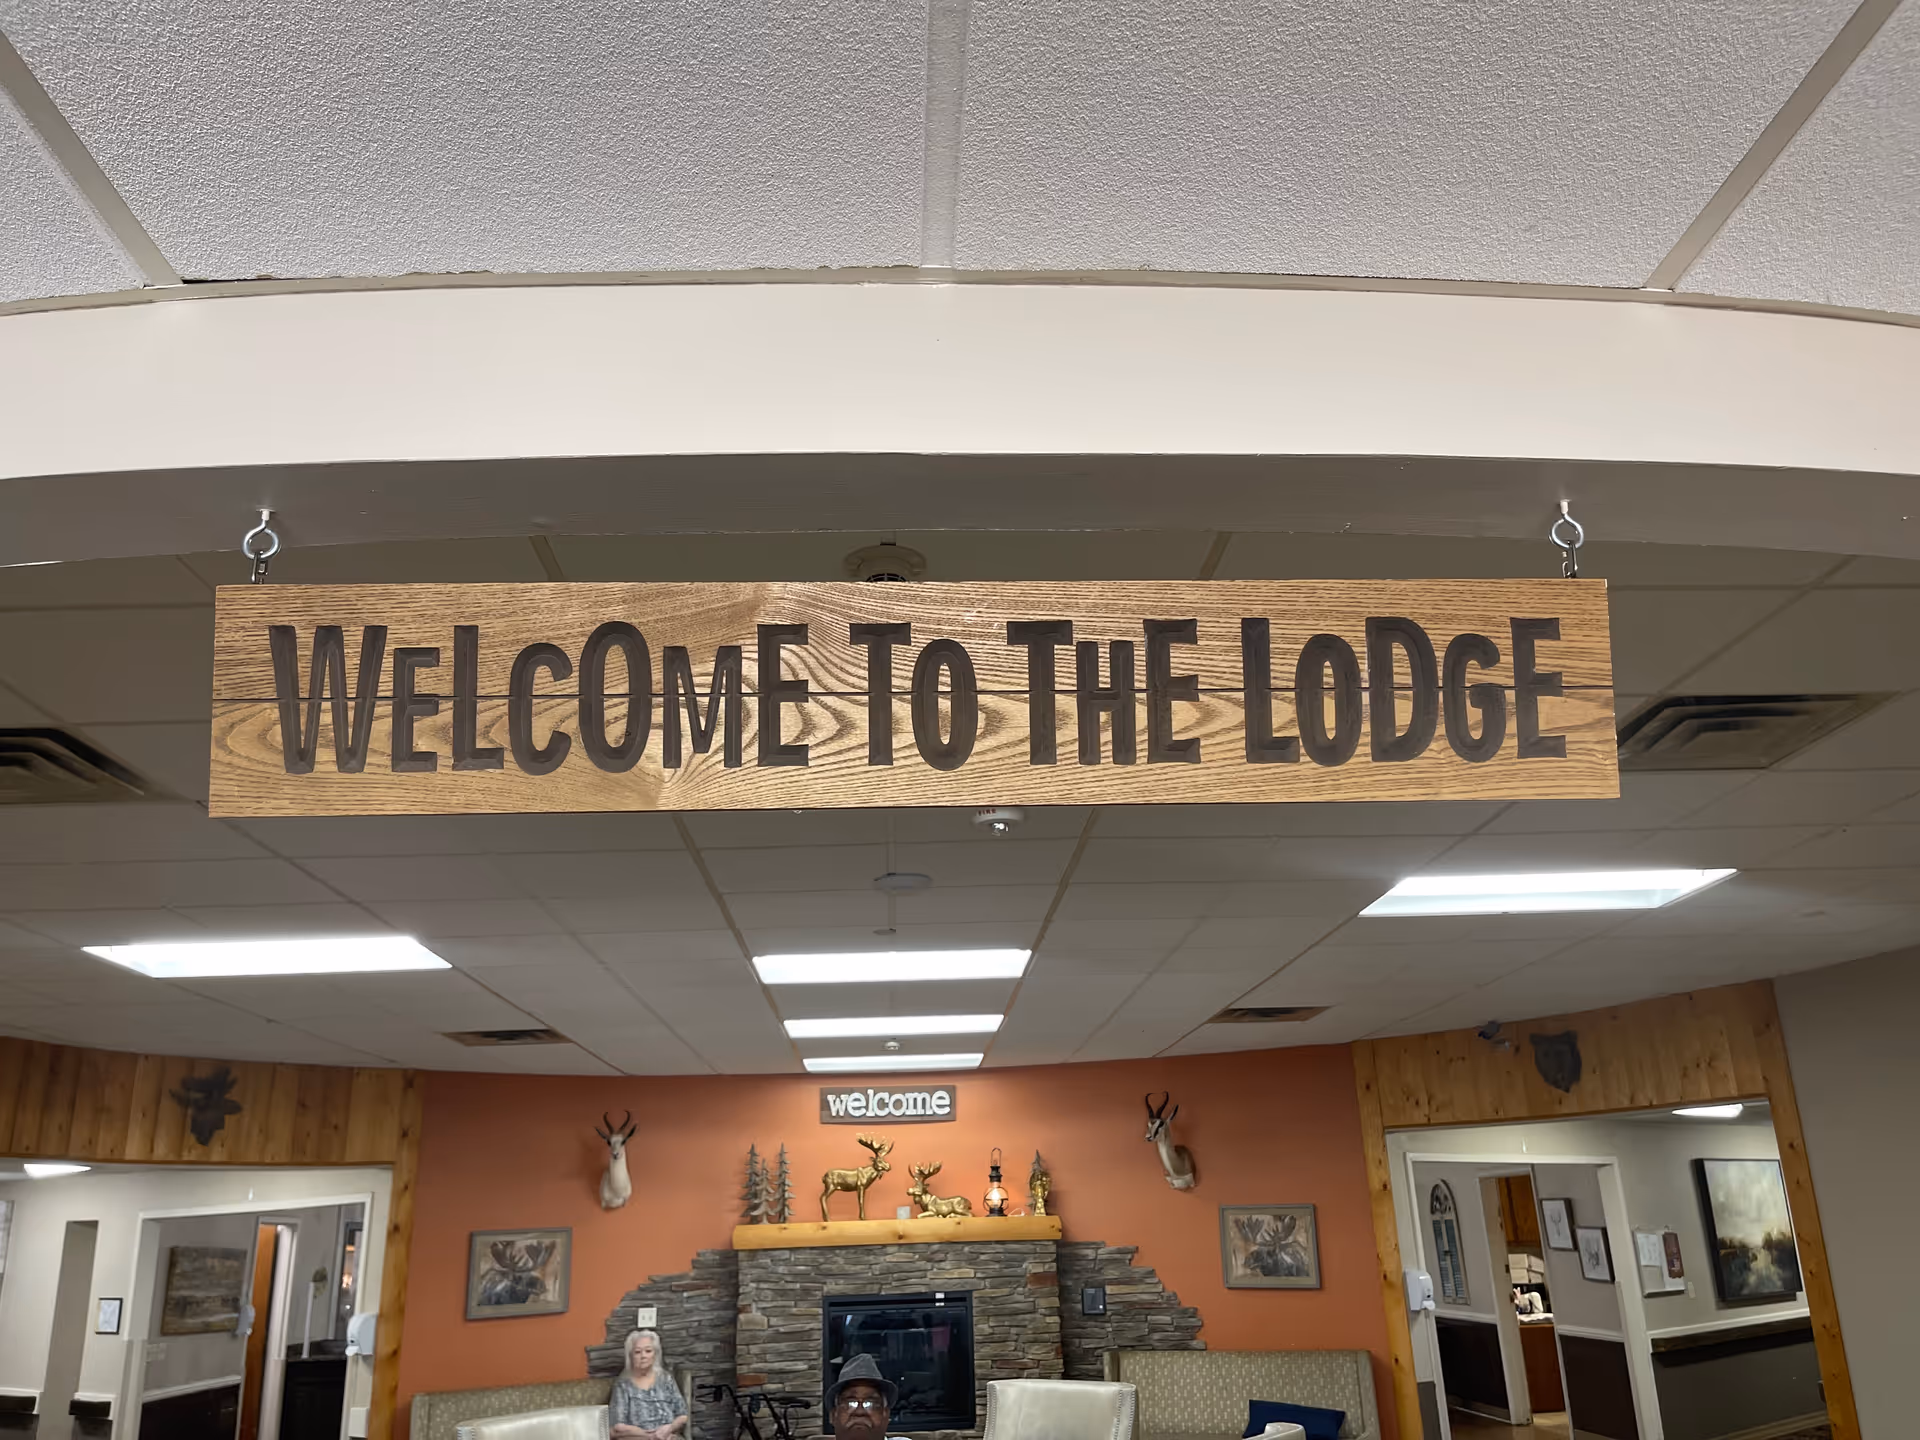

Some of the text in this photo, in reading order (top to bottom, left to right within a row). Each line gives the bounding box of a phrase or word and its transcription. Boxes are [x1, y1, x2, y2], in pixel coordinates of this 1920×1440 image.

[268, 616, 1567, 775] WELCOME TO THE LODGE
[826, 1088, 951, 1117] welcome
